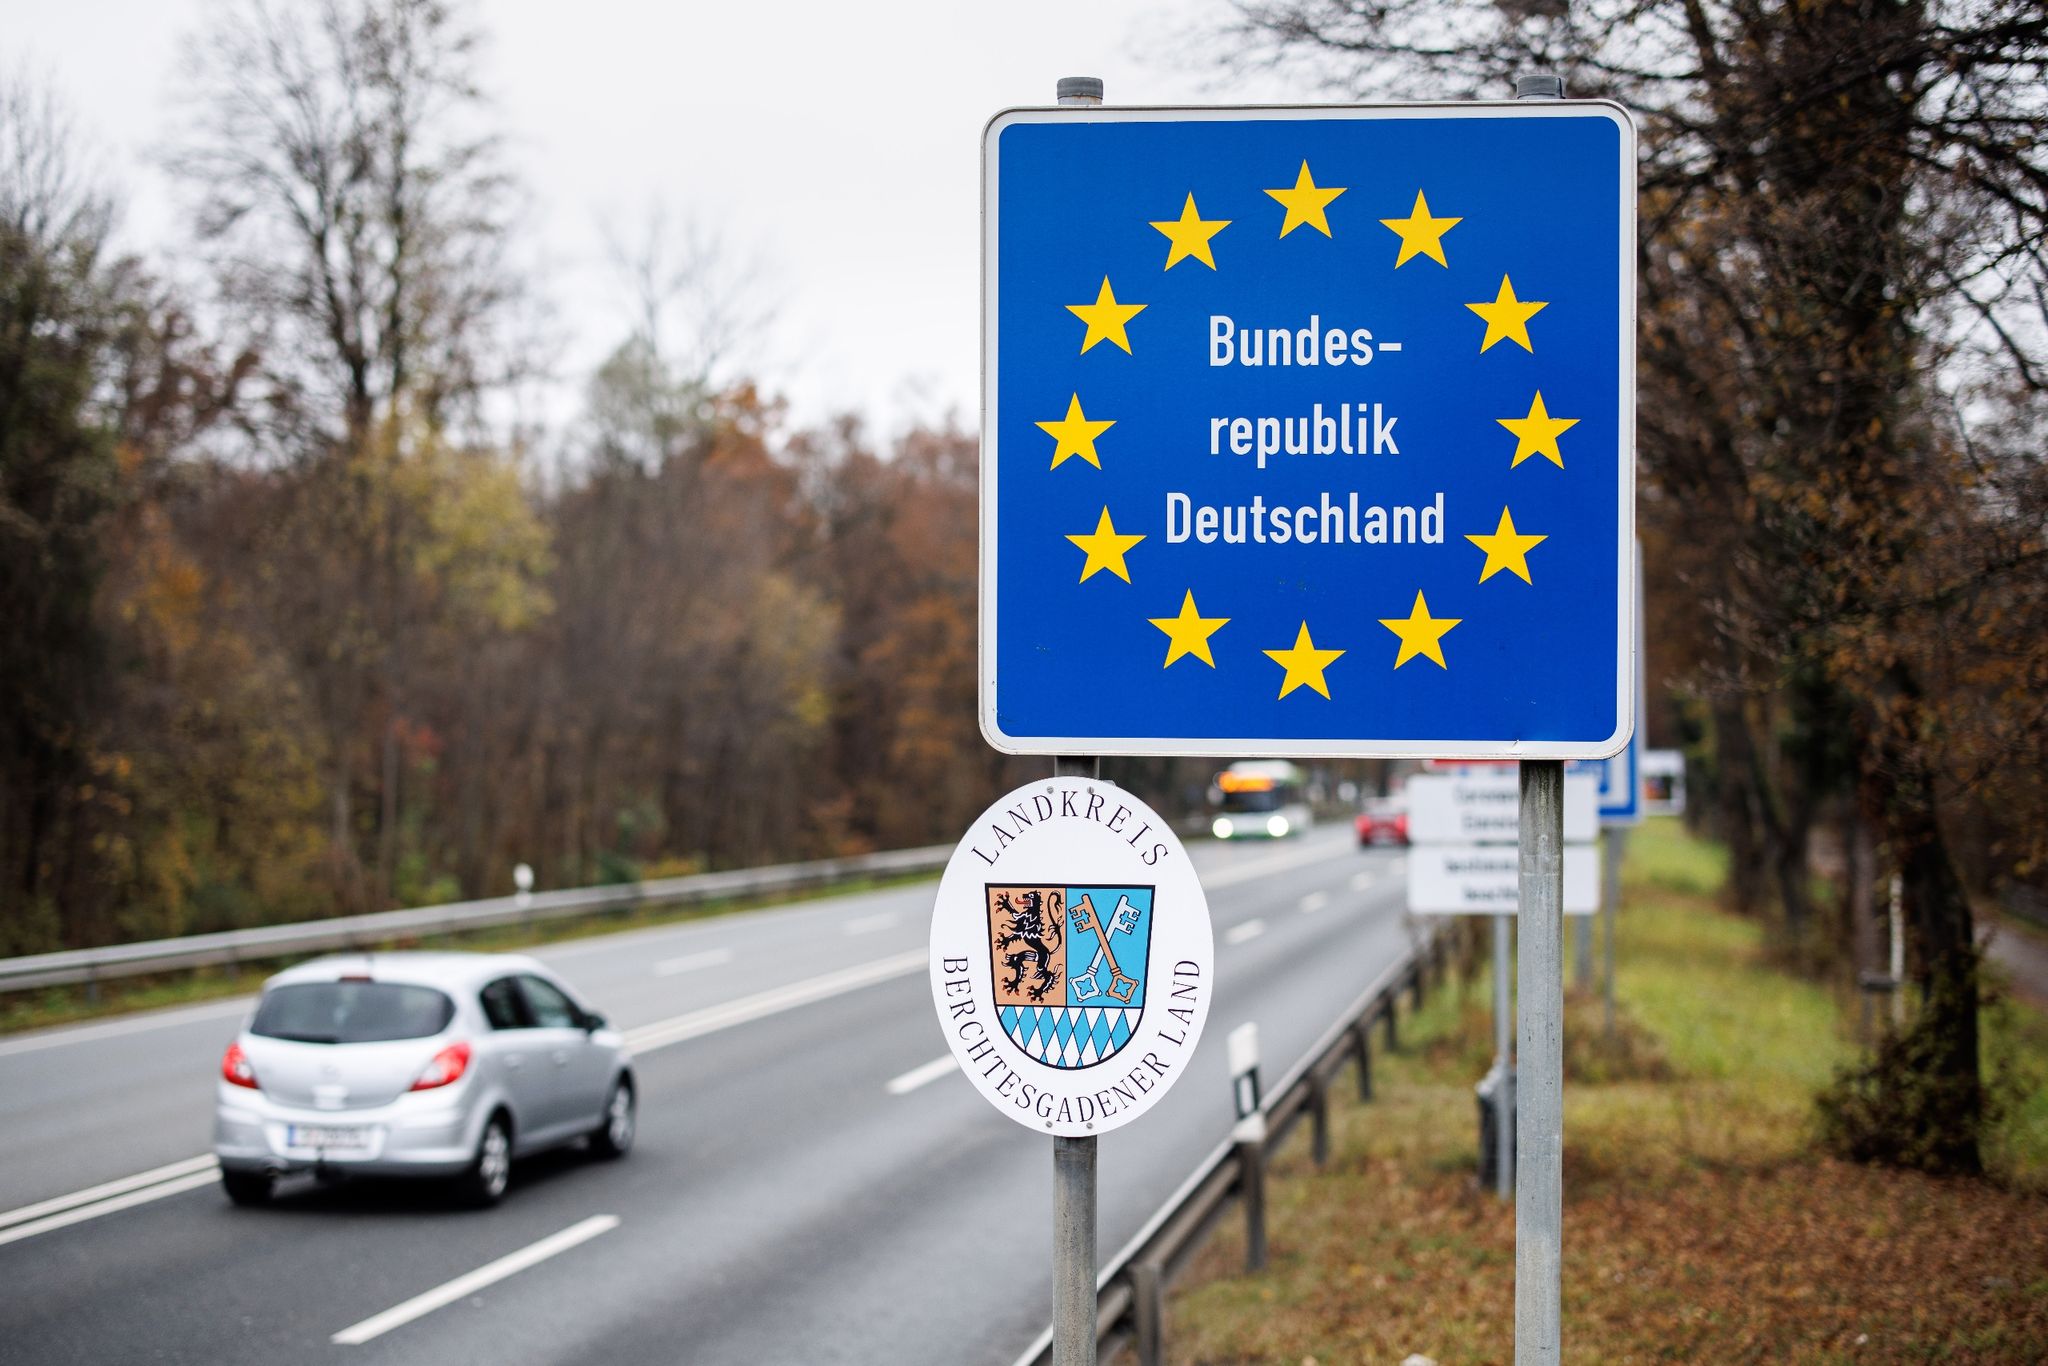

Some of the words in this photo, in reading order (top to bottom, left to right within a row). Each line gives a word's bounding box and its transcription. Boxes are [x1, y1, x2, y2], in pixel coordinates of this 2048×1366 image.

[1210, 315, 1401, 366] Bundes-
[1211, 403, 1399, 468] republik
[1167, 493, 1443, 543] Deutschland
[971, 791, 1168, 866] LANDKREIS
[943, 956, 1170, 1123] BERCHTESGADENER
[1159, 960, 1200, 1048] LAND
